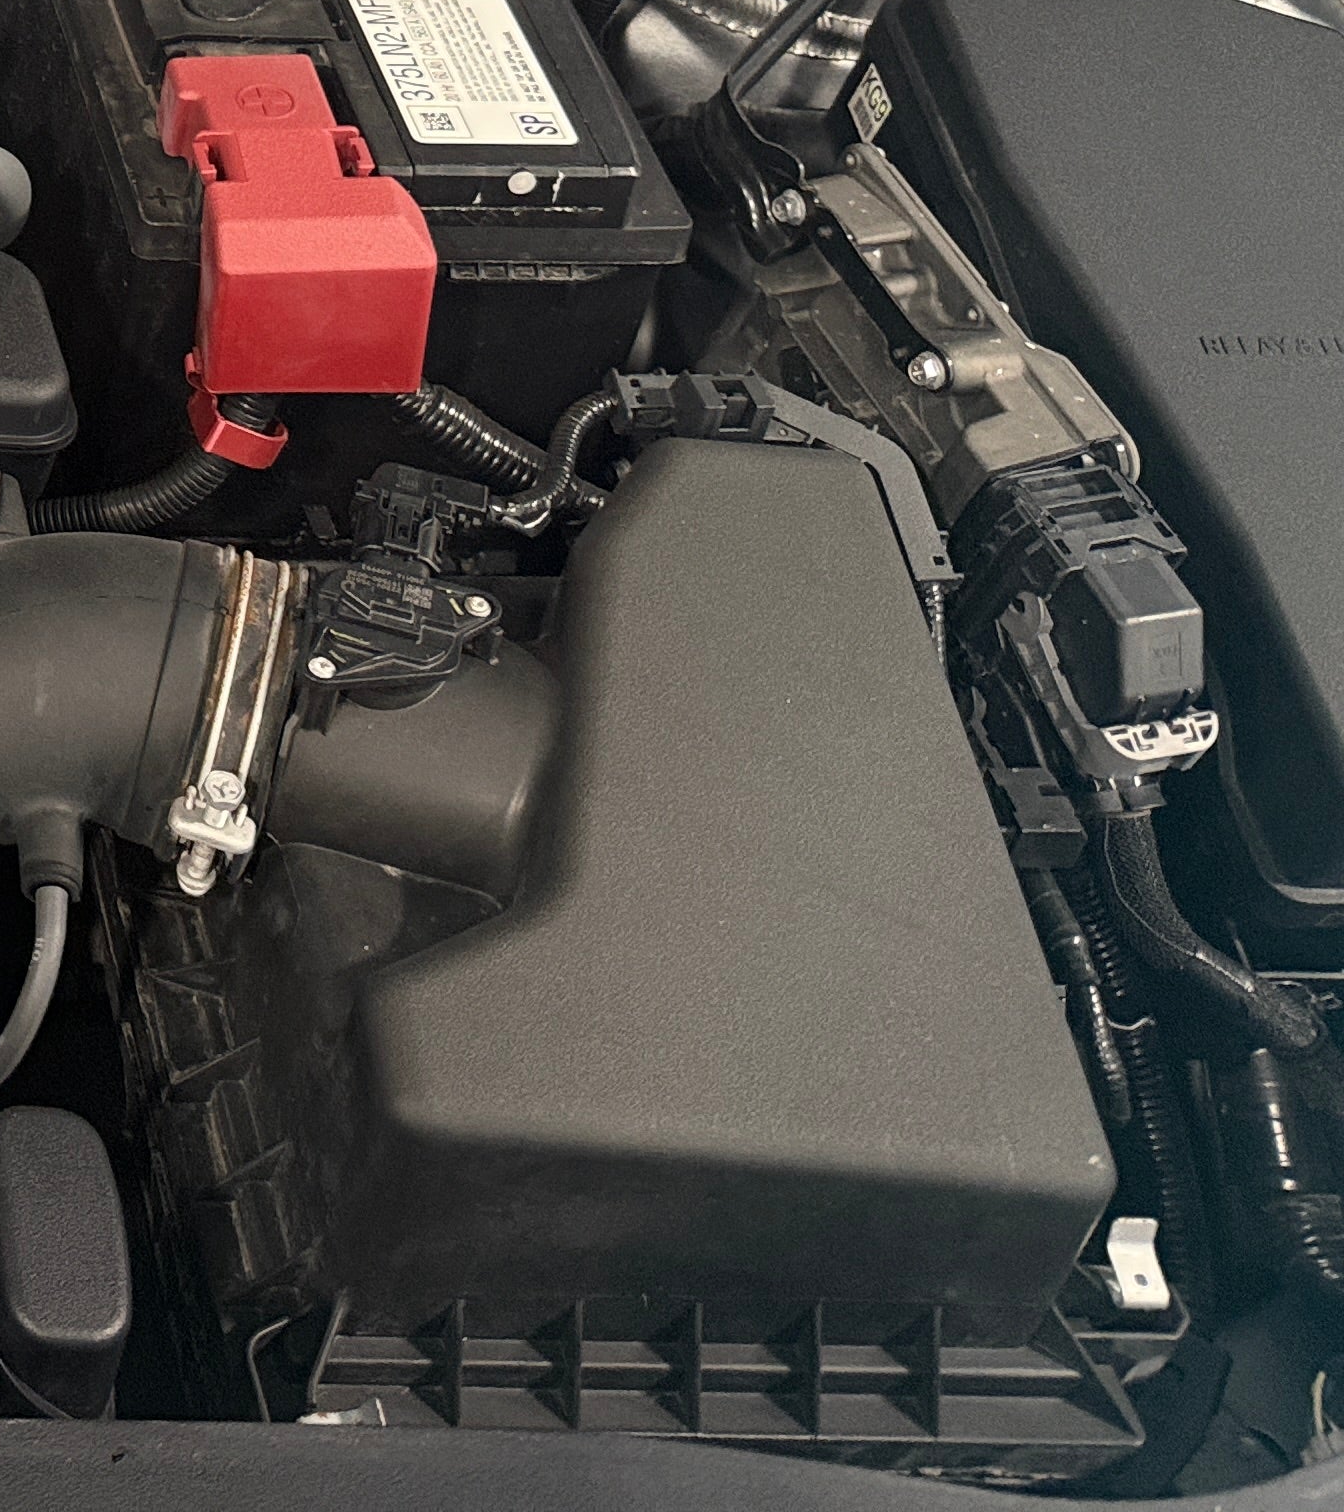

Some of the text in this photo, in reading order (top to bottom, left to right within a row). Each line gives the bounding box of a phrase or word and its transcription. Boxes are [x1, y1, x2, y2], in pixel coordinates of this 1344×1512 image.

[862, 68, 888, 122] KG9
[519, 114, 559, 136] SP
[1199, 336, 1285, 355] RELAY
